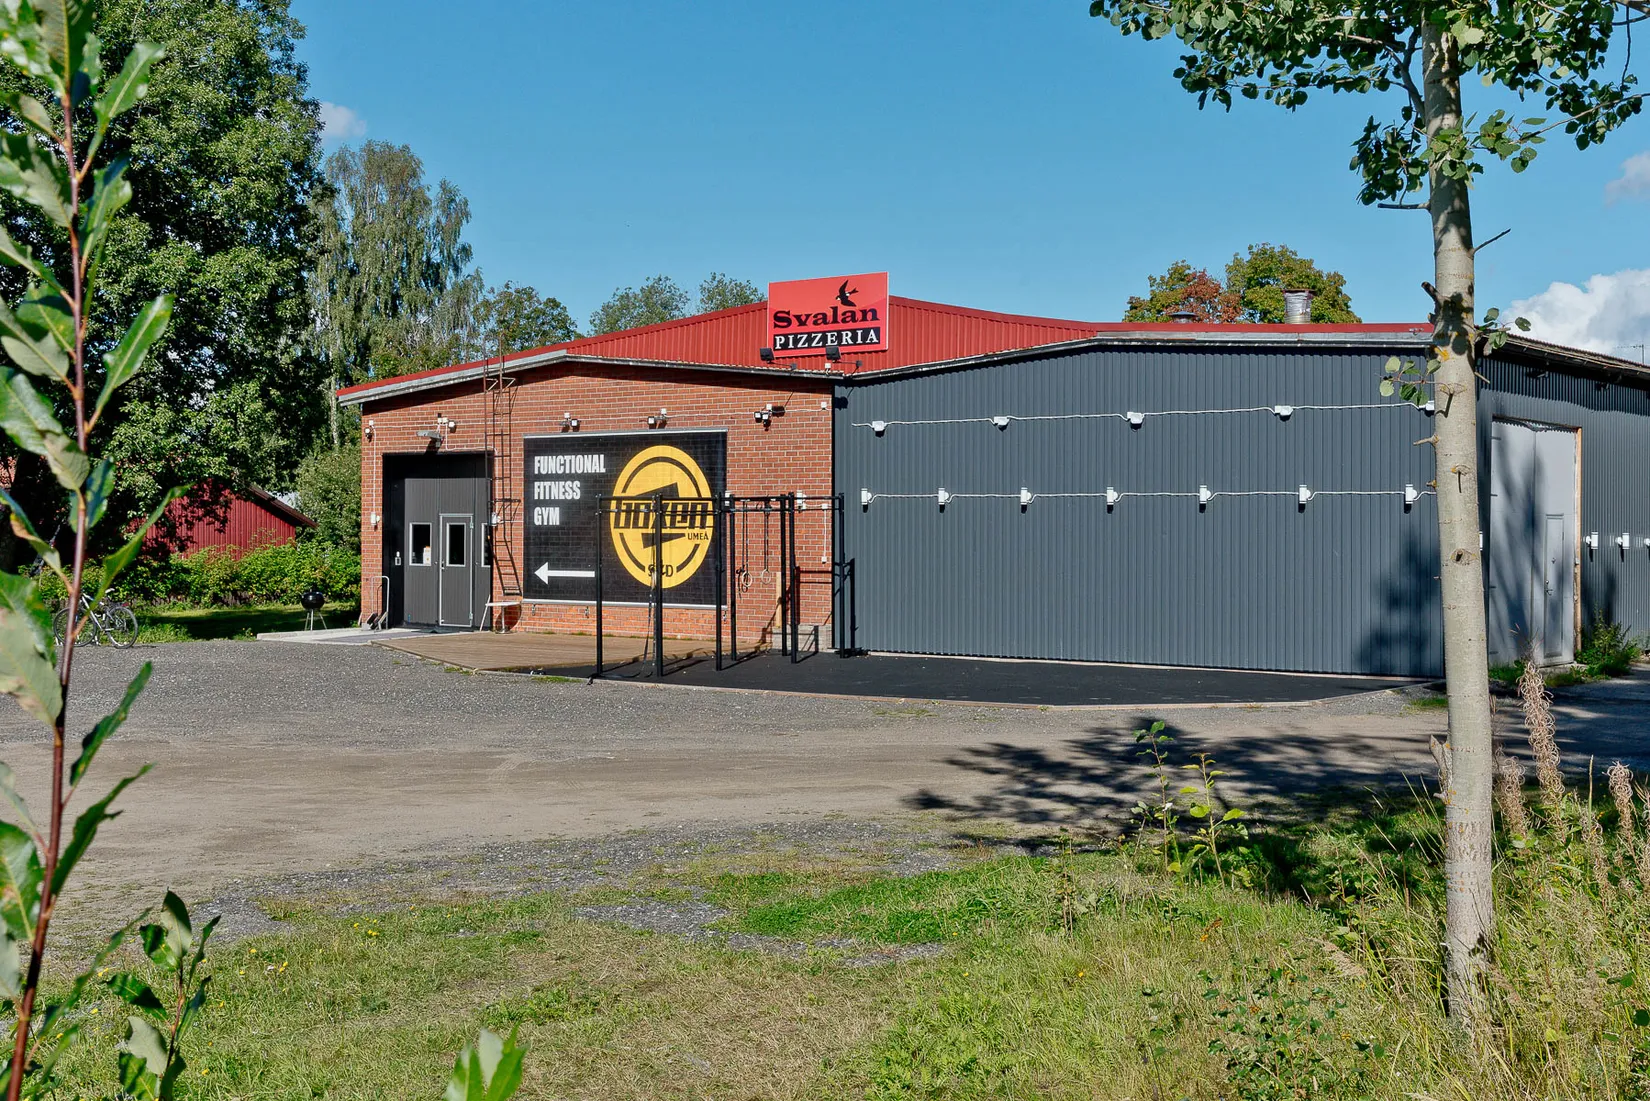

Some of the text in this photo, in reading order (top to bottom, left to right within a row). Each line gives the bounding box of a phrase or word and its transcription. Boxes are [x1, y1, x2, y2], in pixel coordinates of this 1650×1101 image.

[773, 306, 880, 329] Svalan
[774, 329, 879, 350] PIZZERIA
[534, 454, 606, 474] FUNCTIONAL
[534, 481, 581, 500] FITNESS
[533, 507, 560, 526] GYM
